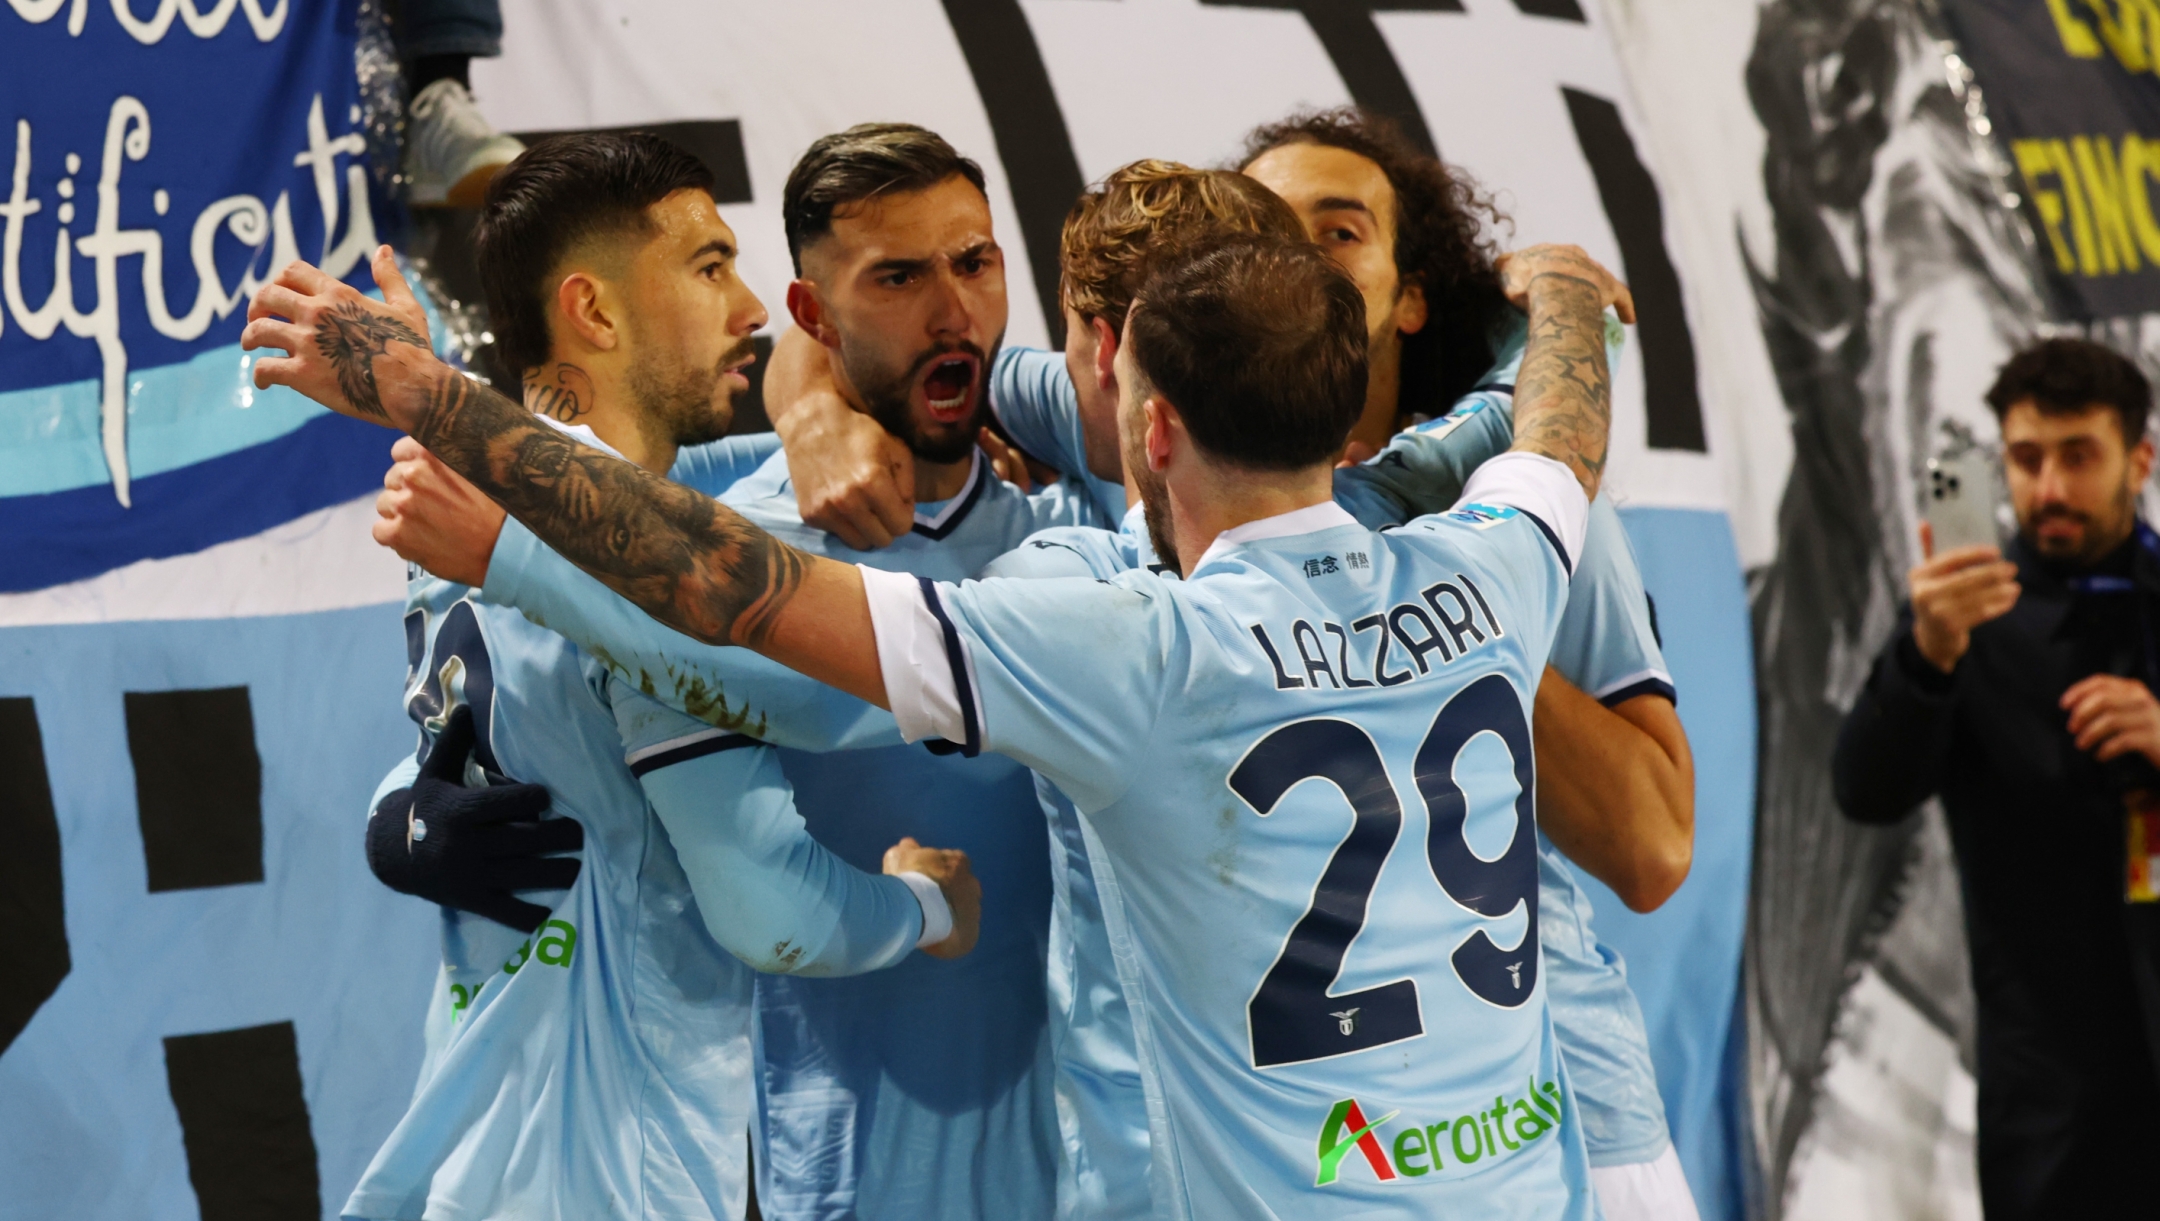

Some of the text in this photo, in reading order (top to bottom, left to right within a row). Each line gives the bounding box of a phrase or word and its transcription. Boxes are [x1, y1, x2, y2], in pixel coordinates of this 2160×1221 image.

[0, 92, 383, 509] tificati
[1249, 572, 1504, 691] LAZZARI
[1302, 555, 1340, 579] 信念
[1225, 673, 1541, 1071] 29
